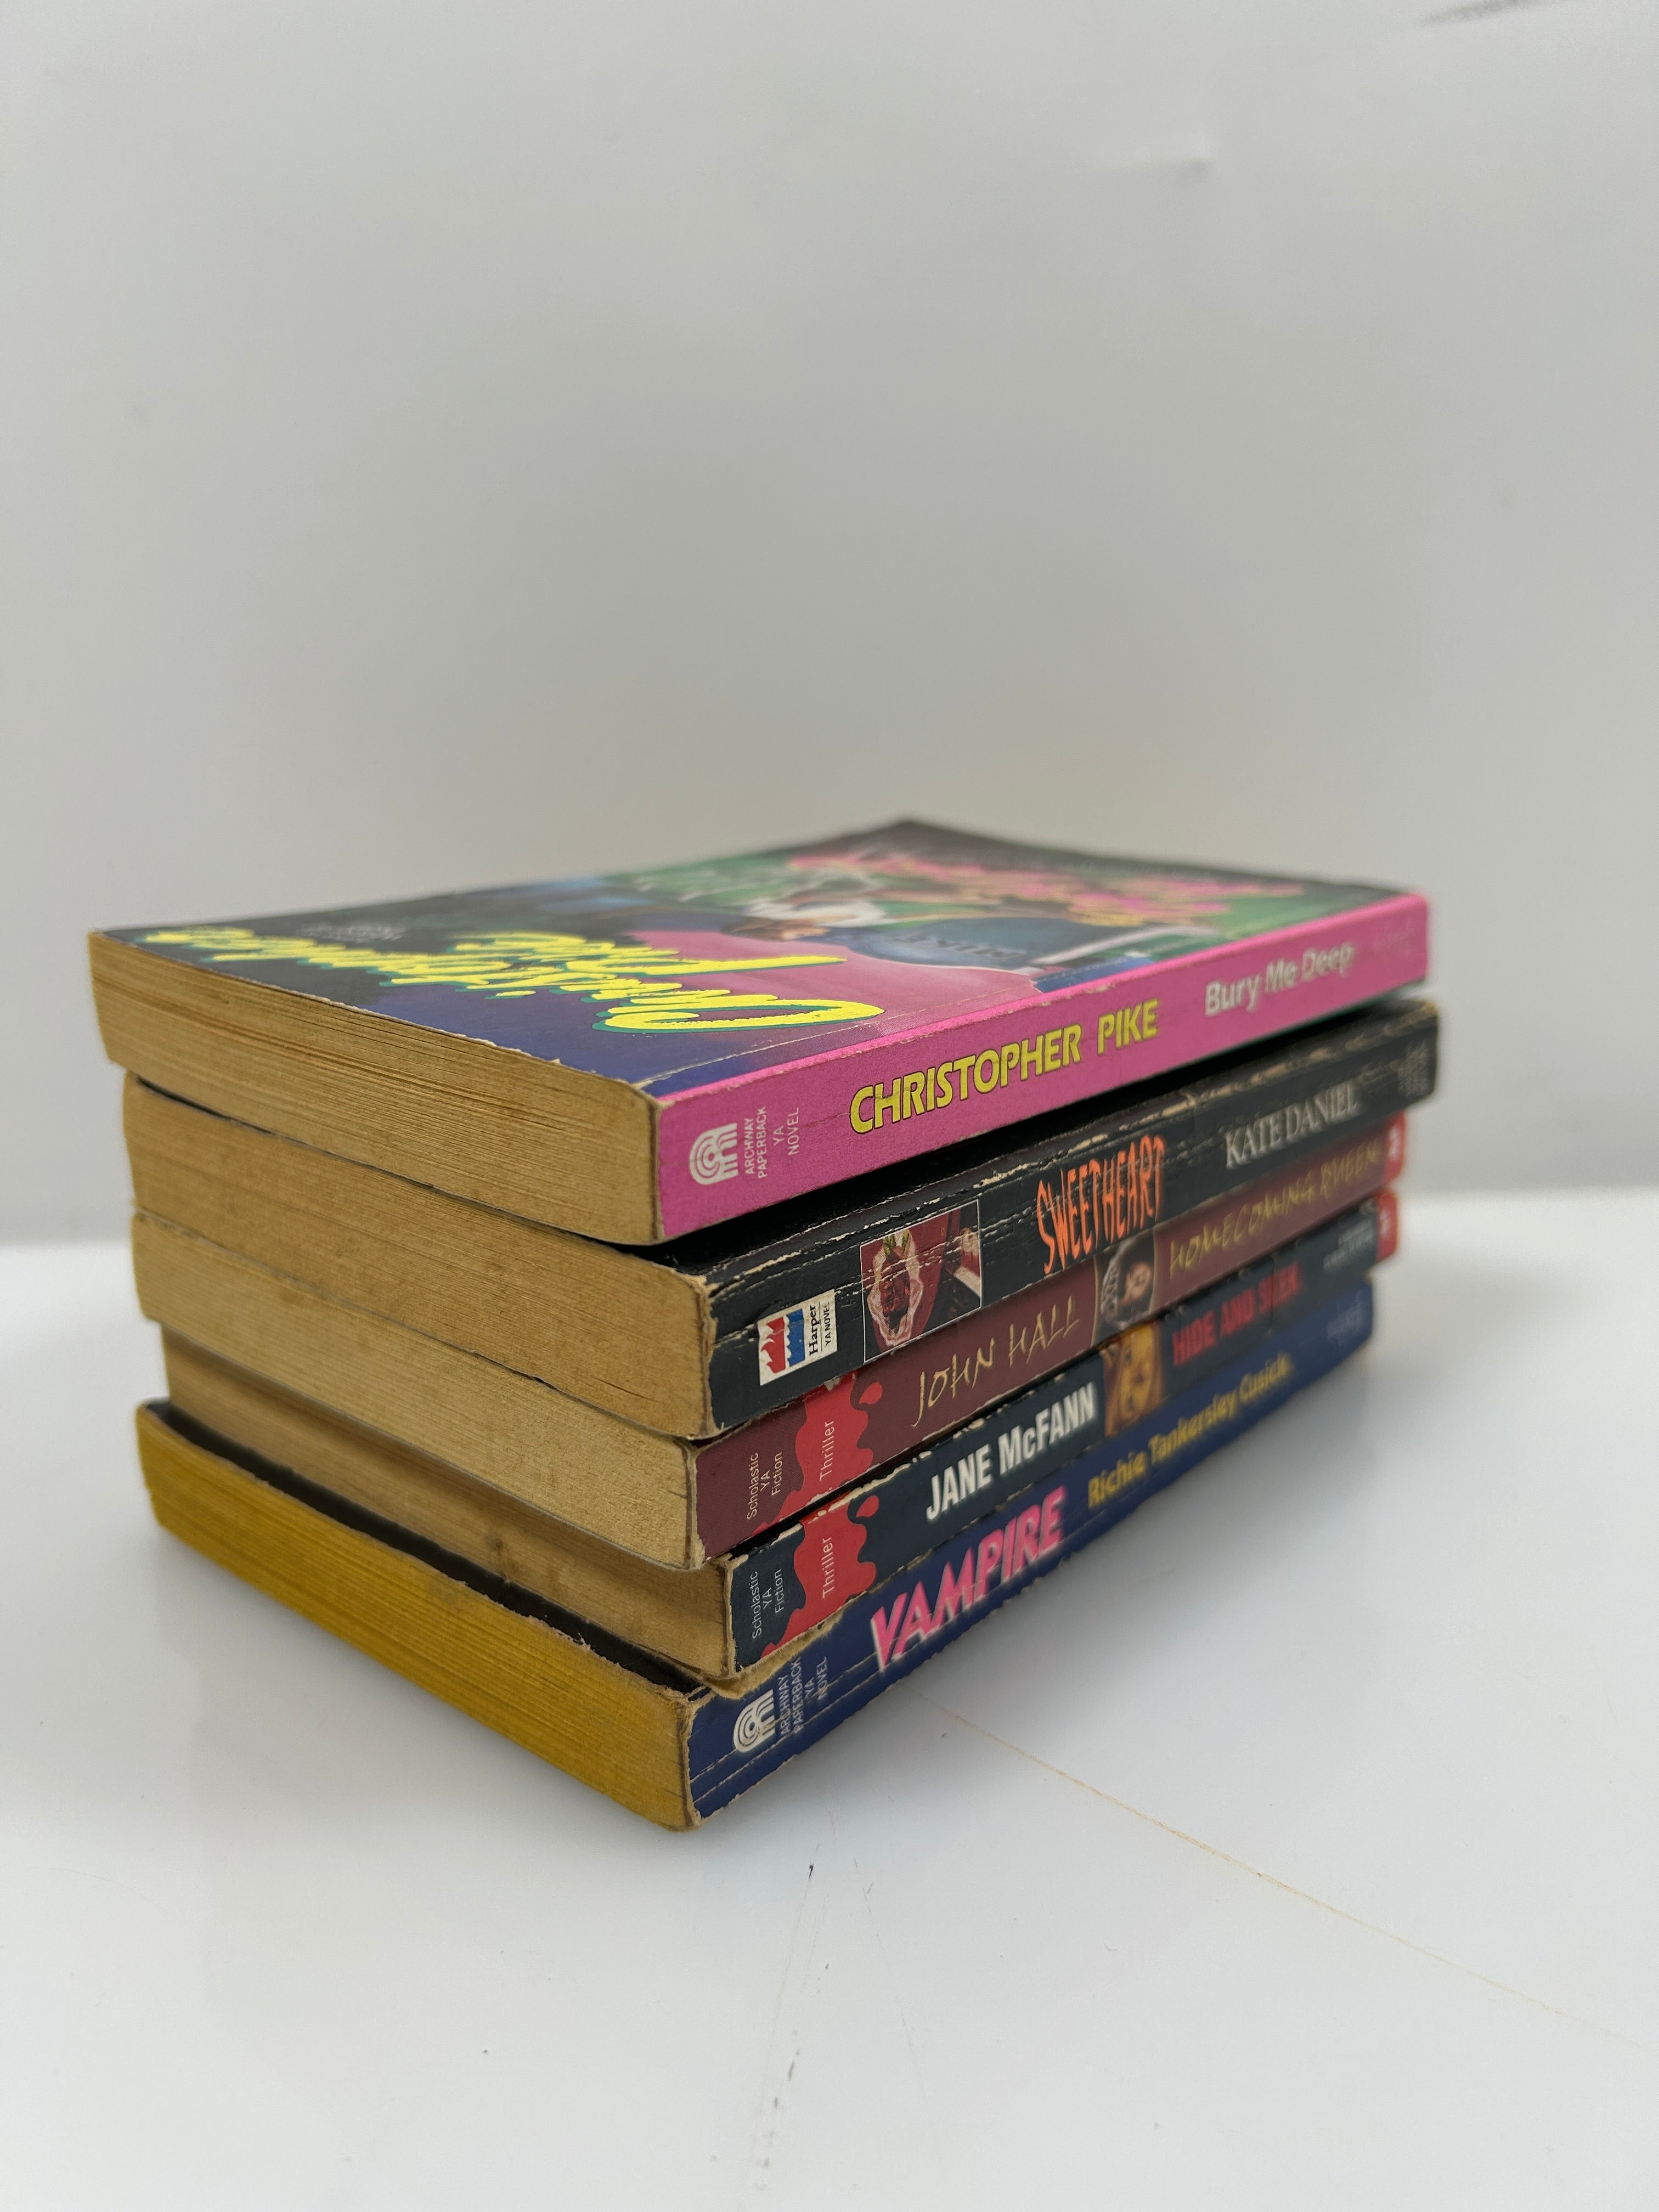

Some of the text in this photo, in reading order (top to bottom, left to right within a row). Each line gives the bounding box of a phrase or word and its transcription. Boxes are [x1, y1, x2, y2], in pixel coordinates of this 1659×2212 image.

[1204, 974, 1260, 1017] Bury
[1265, 957, 1297, 994] Me
[1301, 941, 1354, 978] Deep
[849, 998, 1160, 1134] CHRISTOPHER PIKE
[744, 1118, 754, 1175] ARCHWAY
[756, 1106, 767, 1178] PAPERBACK
[773, 1126, 785, 1146] YA
[787, 1107, 799, 1156] NOVEL
[1224, 1109, 1283, 1169] KATE
[1285, 1081, 1358, 1143] DANIEL
[1036, 1135, 1165, 1274] SWEETHEART
[1170, 1170, 1315, 1280] HOMECOMING
[809, 1305, 821, 1356] Harper
[825, 1332, 831, 1346] YA
[1172, 1310, 1216, 1366] HIDE
[1220, 1288, 1255, 1338] AND
[912, 1296, 1079, 1427] JOHN HALL
[760, 1470, 771, 1492] YA
[771, 1452, 782, 1496] Fiction
[819, 1420, 834, 1481] Thriller
[926, 1381, 1096, 1521] JANE McFANN
[1088, 1451, 1148, 1509] Richie
[747, 1452, 759, 1520] Scholastic
[762, 1587, 772, 1610] YA
[774, 1568, 785, 1614] Fiction
[821, 1537, 835, 1599] Thriller
[871, 1485, 1068, 1671] VAMPIRE
[748, 1571, 762, 1639] Scholastic
[778, 1674, 791, 1736] ARCHWAY
[791, 1656, 804, 1734] PAPERBACK
[804, 1677, 816, 1701] YA
[816, 1656, 828, 1701] NOVEL
